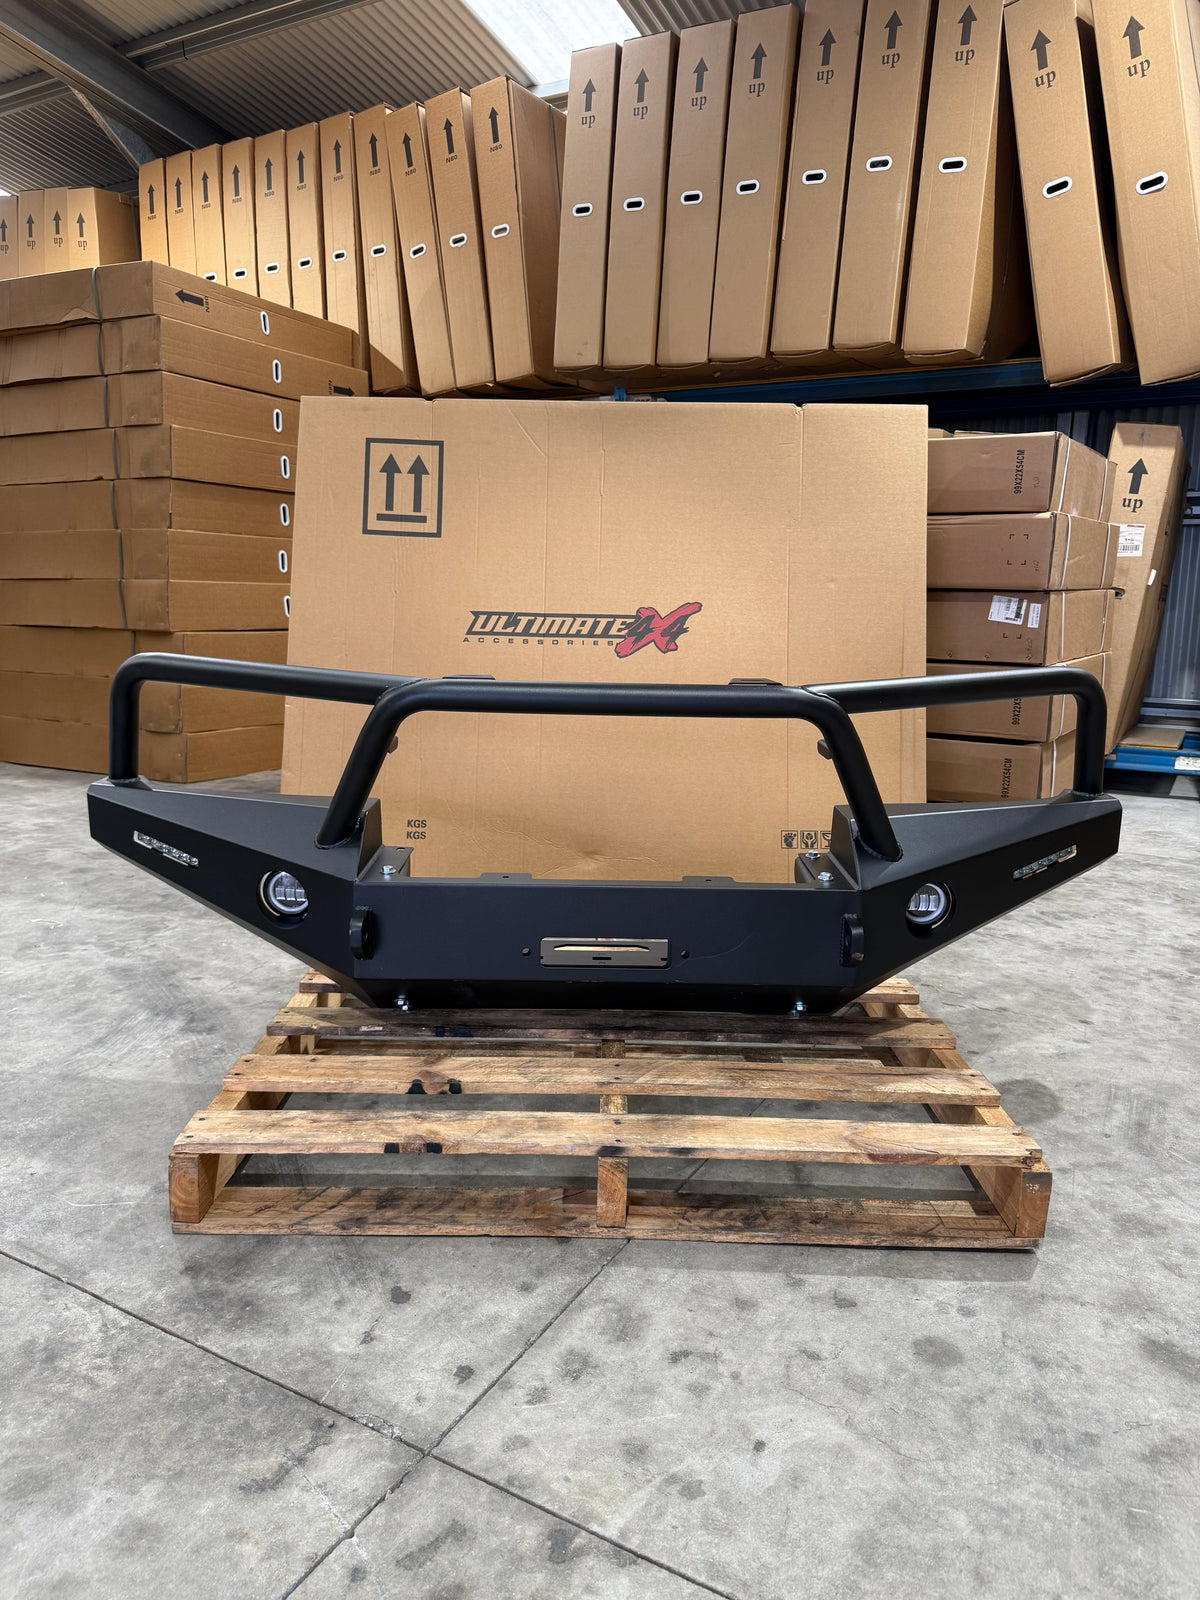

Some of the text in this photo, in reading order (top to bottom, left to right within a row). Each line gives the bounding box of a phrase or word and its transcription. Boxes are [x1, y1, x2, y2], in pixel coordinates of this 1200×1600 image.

[881, 51, 901, 68] up
[955, 47, 975, 65] up
[1127, 58, 1151, 77] up
[816, 68, 835, 84] up
[1034, 70, 1056, 88] up
[748, 82, 766, 97] up
[691, 95, 707, 110] up
[633, 104, 649, 119] up
[581, 113, 596, 128] up
[489, 144, 503, 153] N80
[445, 154, 458, 164] N80
[333, 174, 344, 182] N80
[369, 168, 381, 177] N80
[404, 167, 417, 177] N80
[297, 183, 307, 191] N80
[174, 207, 184, 215] N80
[26, 240, 36, 250] up
[54, 237, 64, 247] up
[78, 240, 88, 250] up
[1014, 450, 1025, 495] 99X22X54CM
[1122, 497, 1144, 514] up
[466, 611, 635, 638] ULTIMATE
[463, 637, 614, 646] ACCESSORIES
[1001, 758, 1013, 798] 99X22X54CM
[407, 819, 427, 828] KGS
[406, 831, 426, 840] KGS
